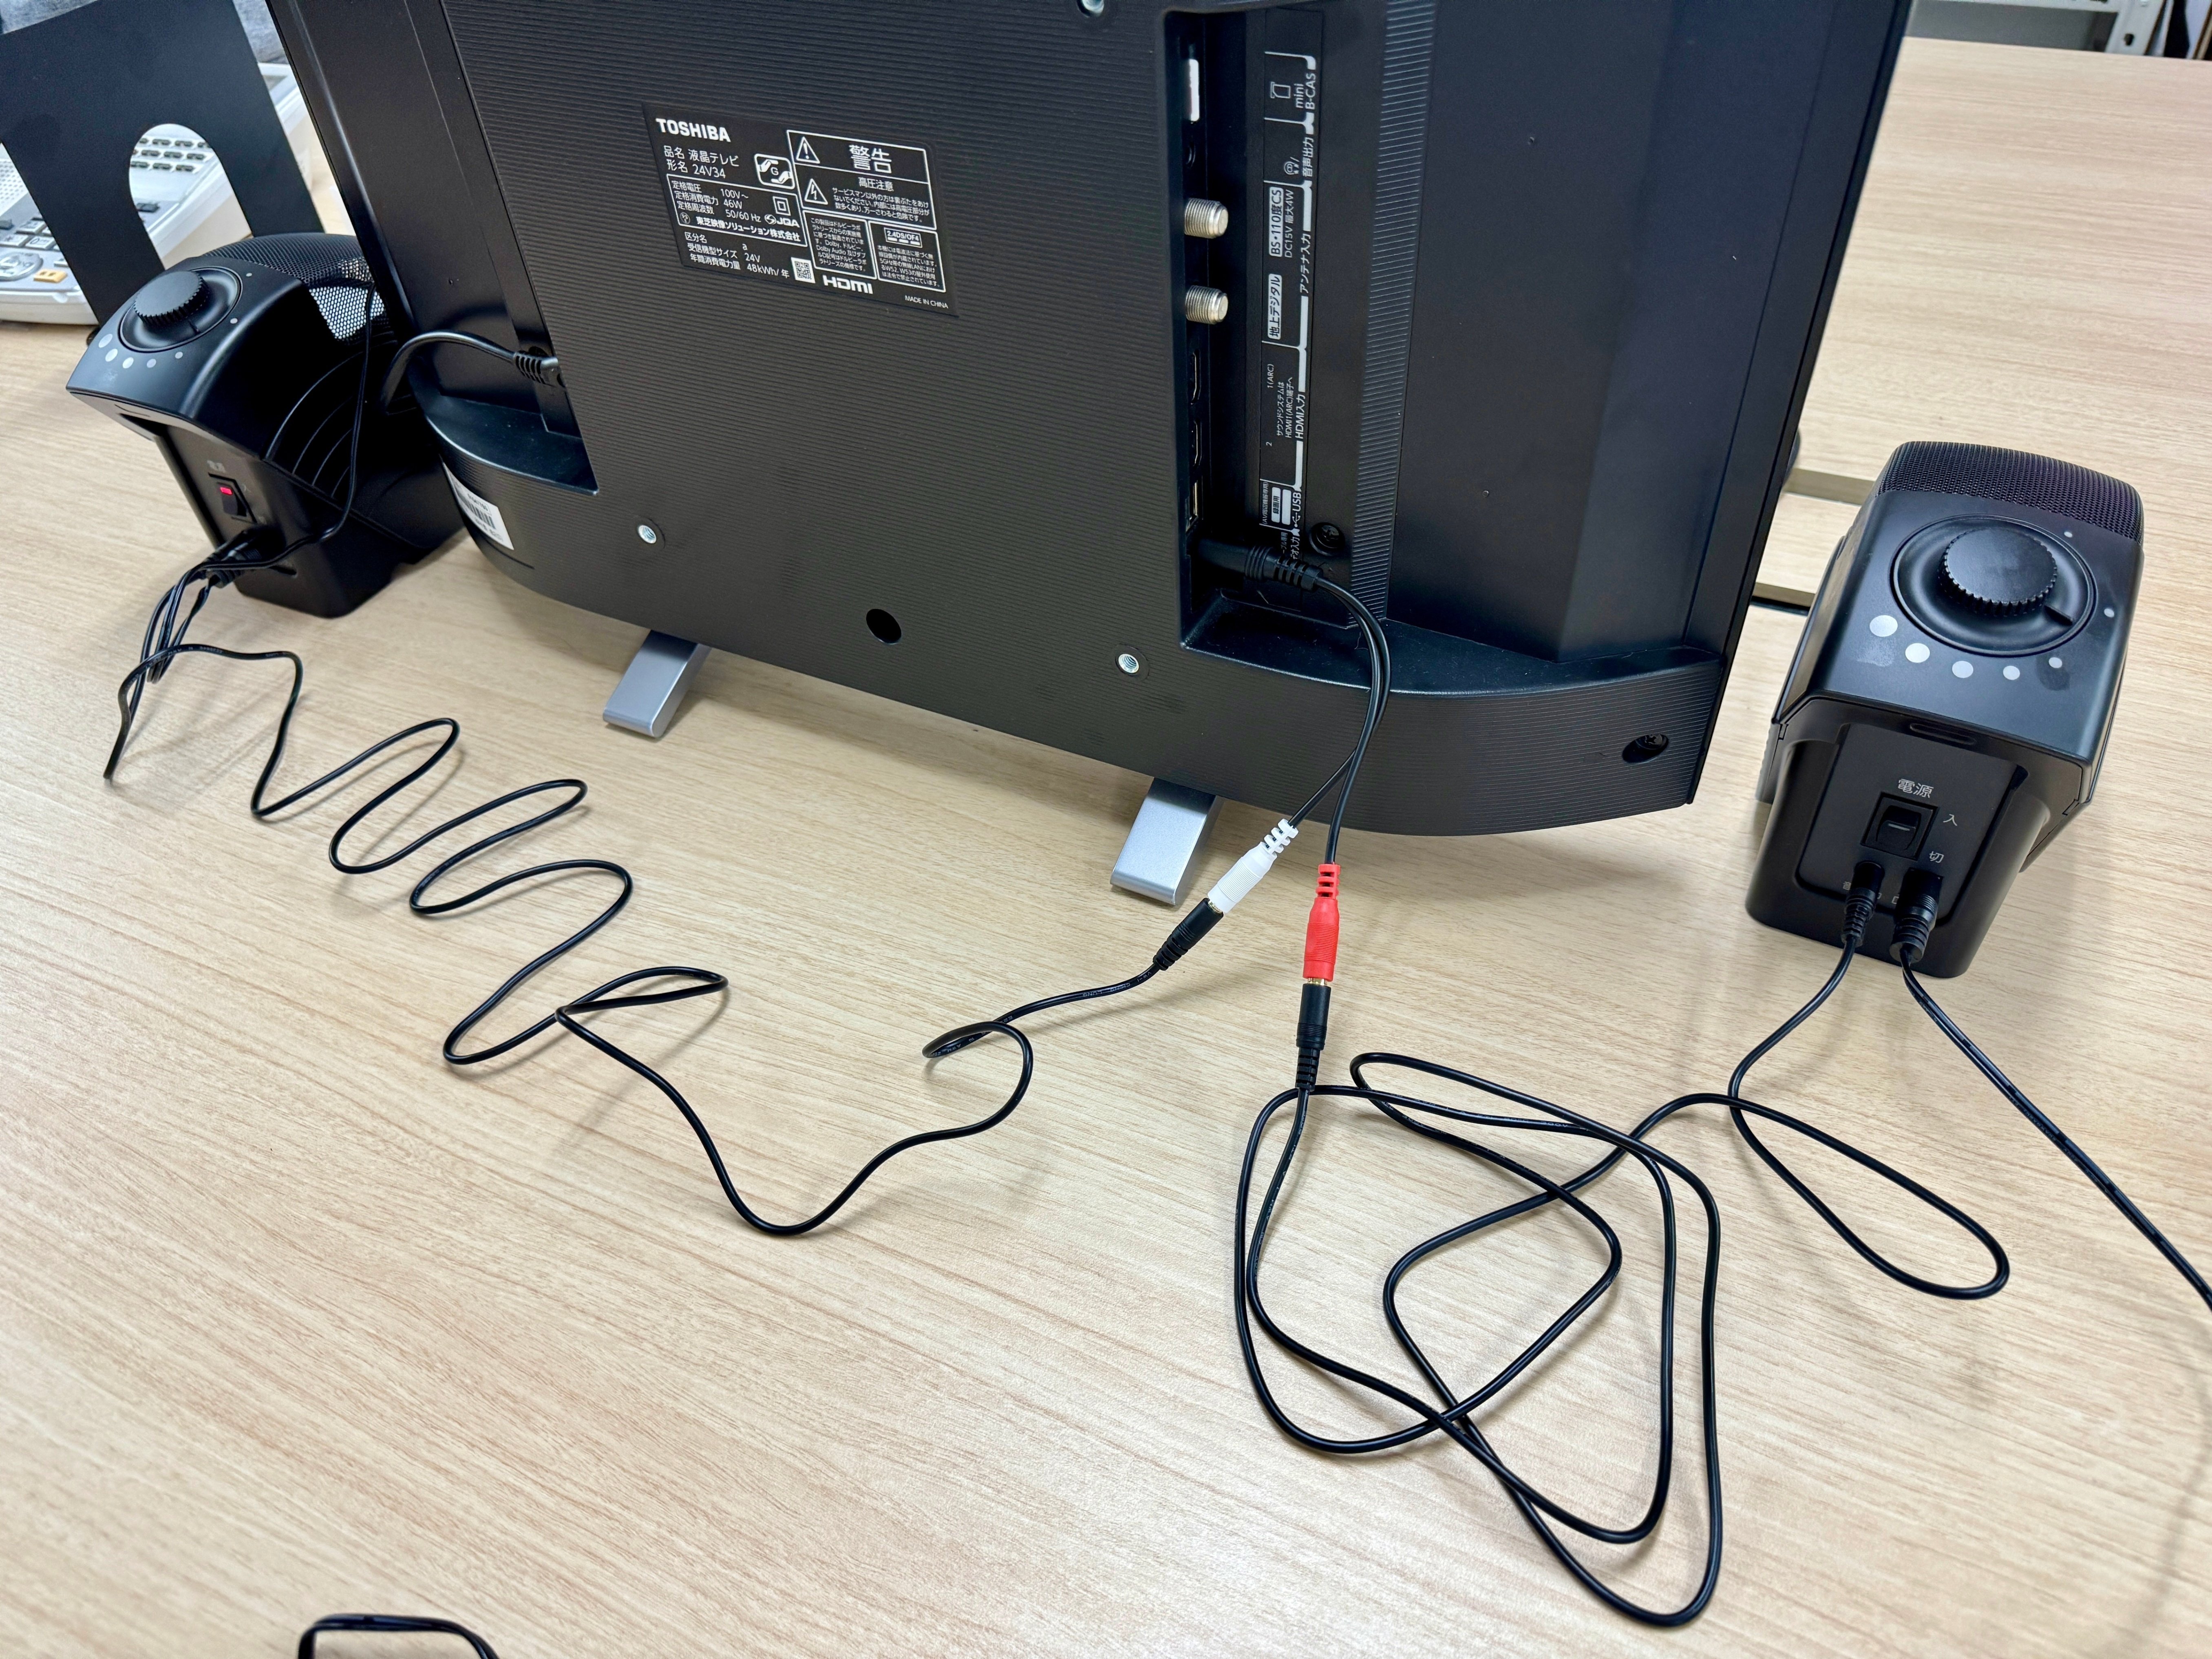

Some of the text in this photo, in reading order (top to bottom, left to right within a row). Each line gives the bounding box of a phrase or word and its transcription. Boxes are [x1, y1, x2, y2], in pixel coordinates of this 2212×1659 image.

[1294, 83, 1305, 109] mini
[1305, 72, 1316, 110] B-CAS
[656, 118, 731, 142] TOSHIBA
[663, 145, 740, 167] 品名 液晶テレビ
[849, 144, 892, 174] 警告
[1302, 136, 1314, 178] 音声出力
[667, 159, 726, 179] 形名 24V34
[671, 180, 702, 194] 定格電圧
[858, 177, 894, 192] 高圧注意
[674, 191, 742, 210] 定格消費電力 46W
[677, 201, 762, 223] 定格周波数 50/60 Hz
[696, 216, 801, 242] 東芝映像ソリューション株式会社
[777, 218, 800, 228] JQA
[1285, 189, 1294, 258] DC15V 最大4W
[684, 232, 707, 243] 区分名
[887, 230, 919, 241] 2.4DS/OF4
[687, 243, 761, 263] 受信機型サイズ 24V
[1300, 233, 1312, 294] アンテナ入力
[690, 253, 741, 270] 年間消費電力量
[781, 269, 790, 279] 年
[823, 275, 873, 294] HDMI
[905, 295, 922, 304] MADE
[930, 300, 949, 309] CHINA
[1269, 276, 1280, 337] 地上デジタル
[1277, 382, 1285, 437] サウンドシステムは
[1295, 394, 1306, 439] HDMI入力
[1292, 492, 1302, 512] USB
[1897, 778, 1934, 798] 電源
[1943, 813, 1958, 827] 入
[1929, 851, 1944, 864] 切
